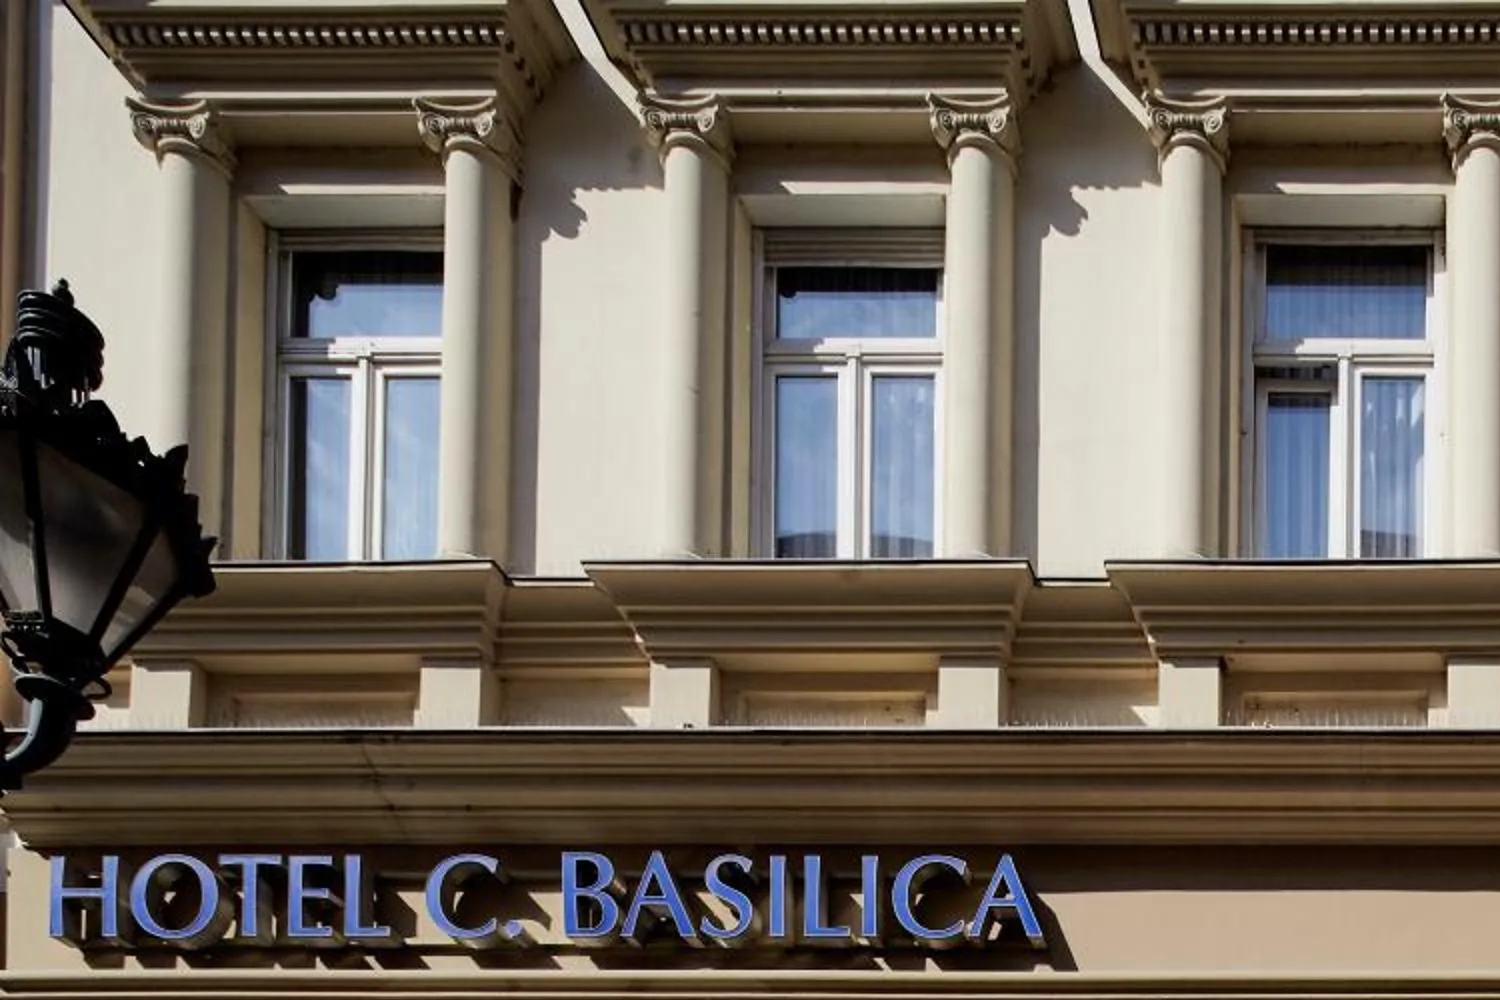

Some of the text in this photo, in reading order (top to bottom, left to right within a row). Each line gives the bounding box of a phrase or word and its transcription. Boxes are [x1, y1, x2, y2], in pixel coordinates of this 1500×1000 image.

[49, 850, 1043, 939] HOTEL C. BASILICA
